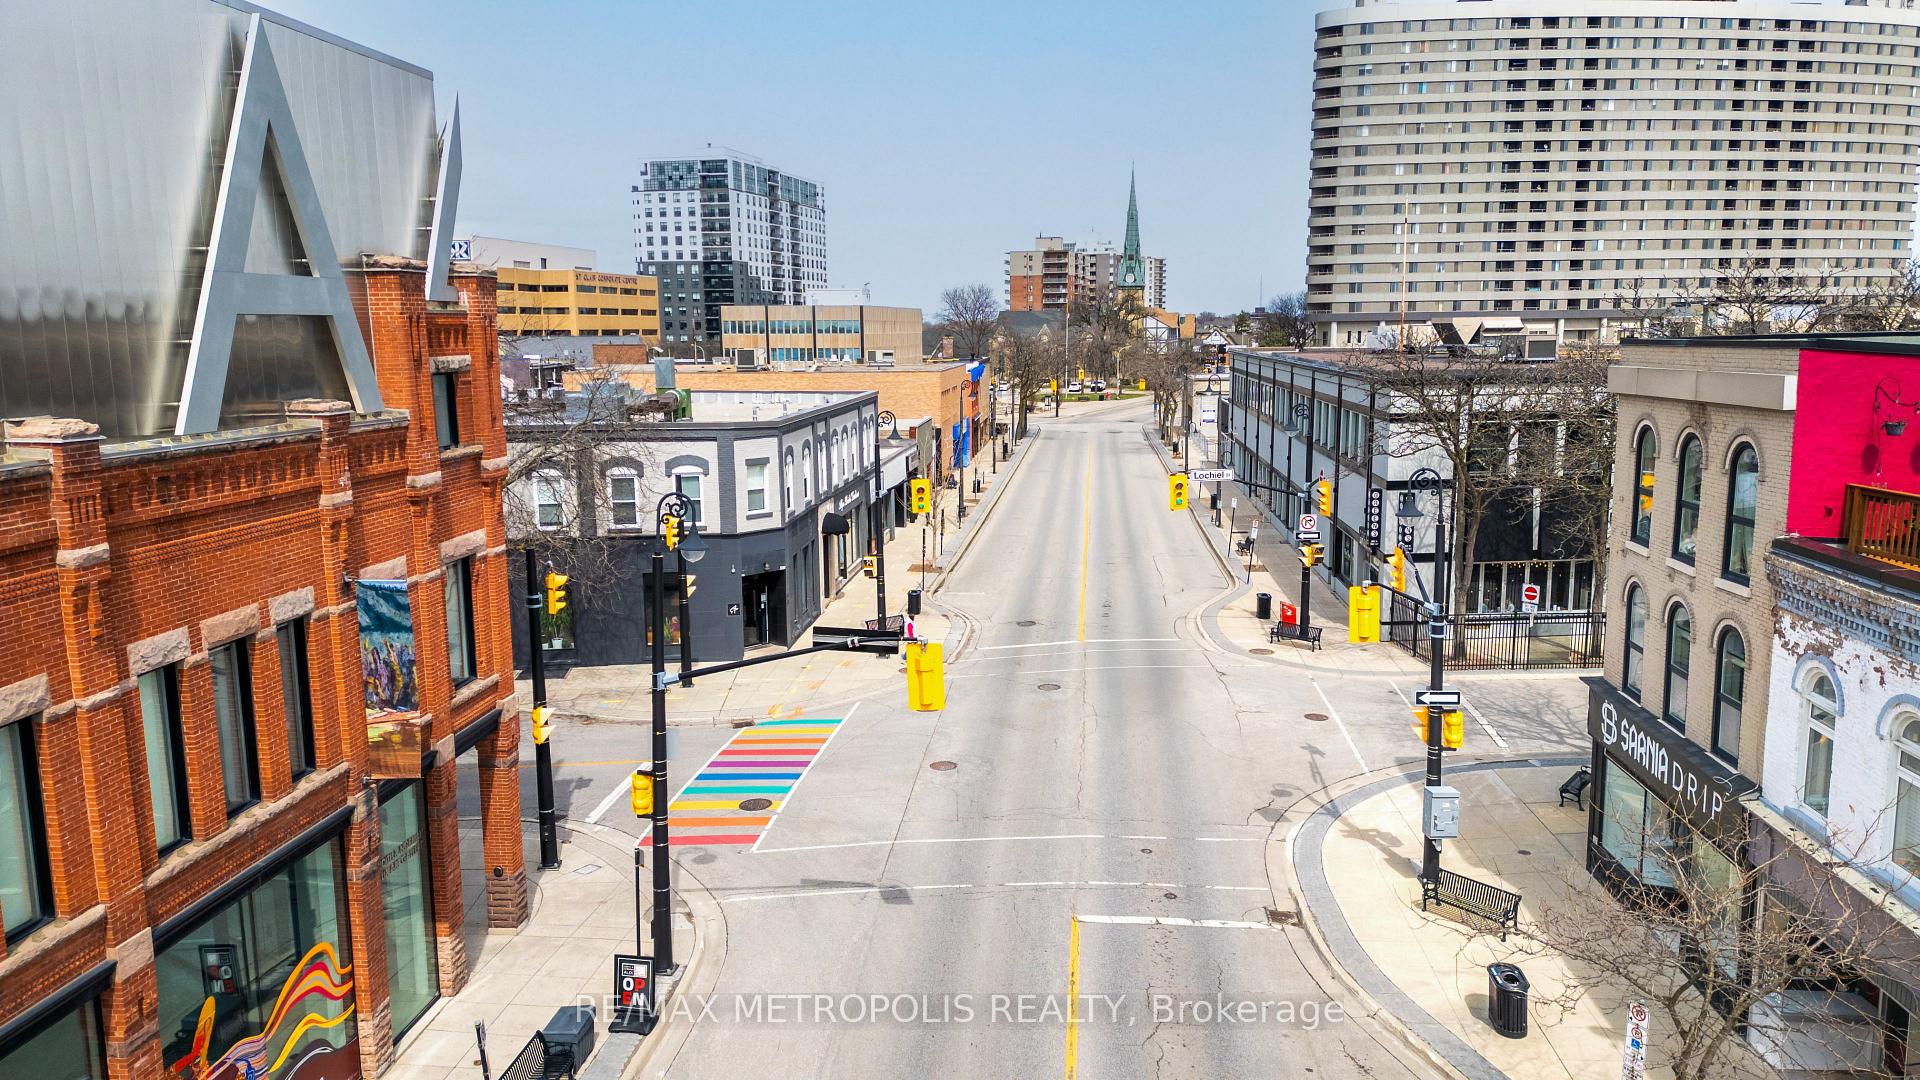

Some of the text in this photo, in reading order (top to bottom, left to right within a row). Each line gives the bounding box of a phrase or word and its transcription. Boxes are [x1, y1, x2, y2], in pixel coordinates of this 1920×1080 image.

[175, 13, 384, 435] A
[1193, 472, 1225, 480] Lochiel
[1620, 718, 1669, 785] SARNIA
[1672, 761, 1723, 820] DRIP
